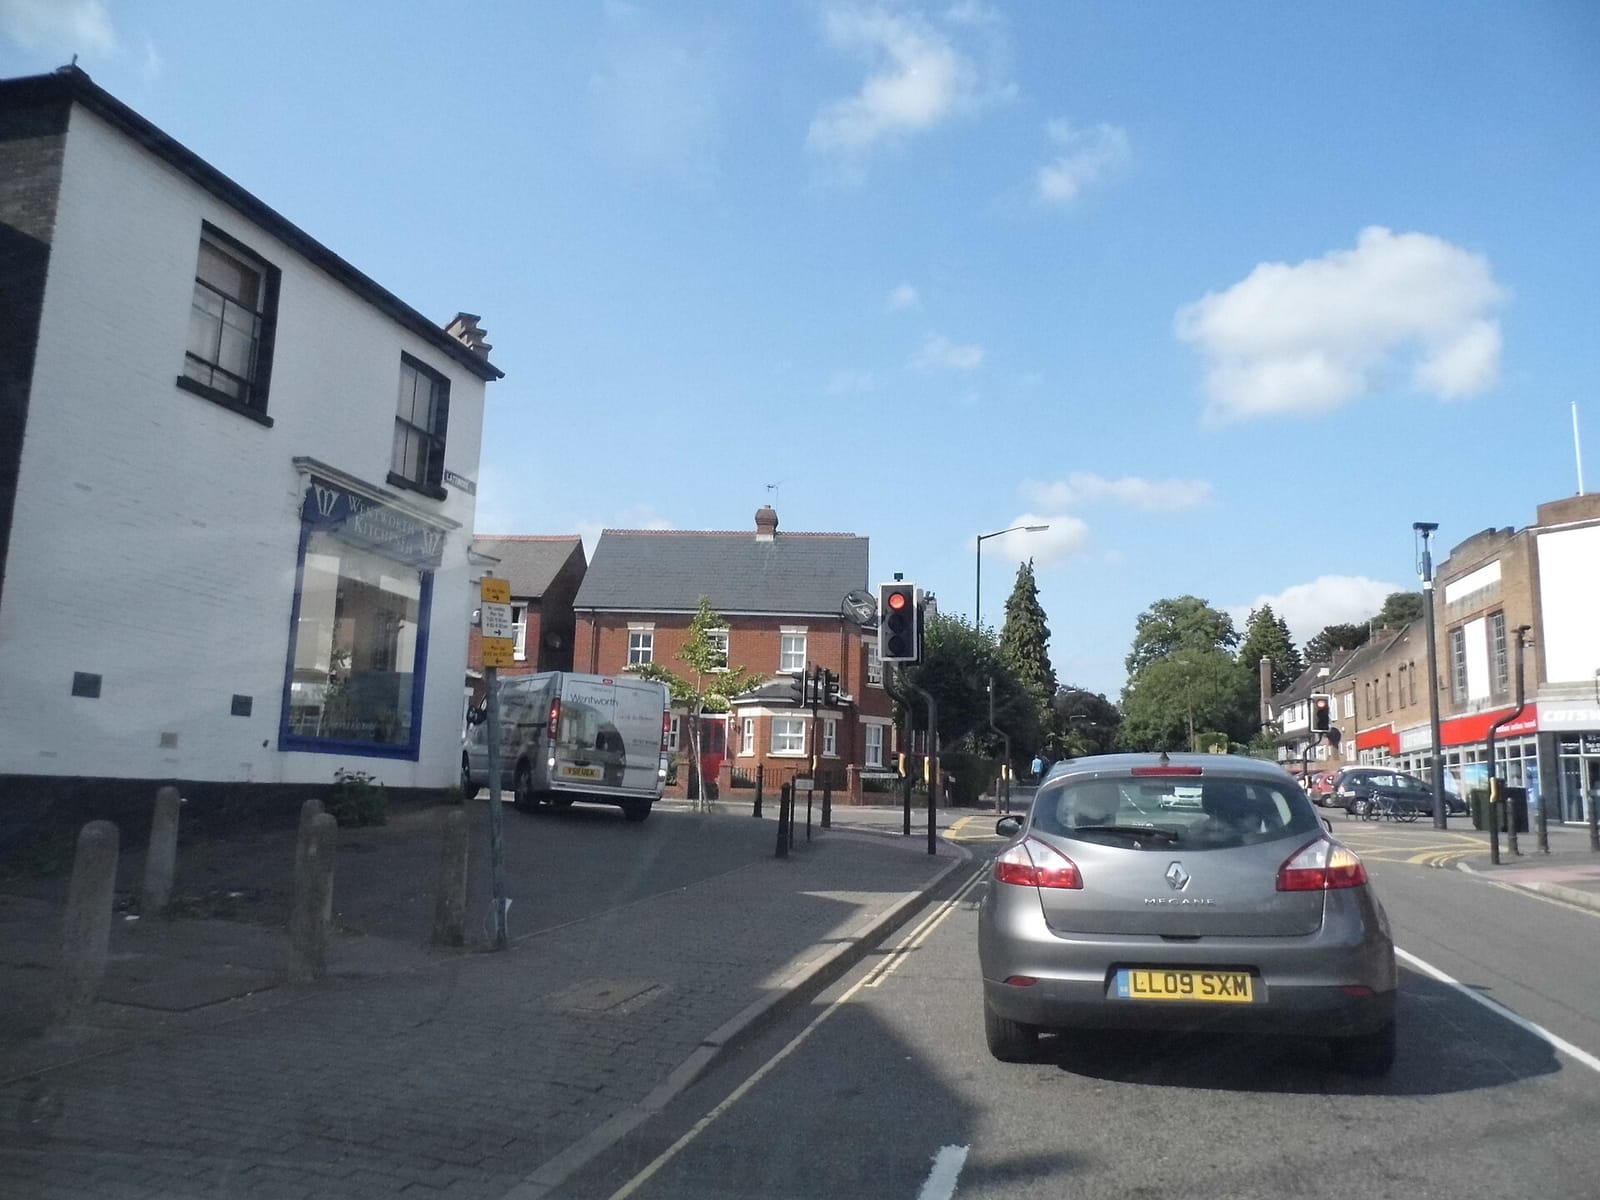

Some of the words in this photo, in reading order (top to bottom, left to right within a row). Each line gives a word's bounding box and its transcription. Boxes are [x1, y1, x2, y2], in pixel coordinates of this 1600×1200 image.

[348, 494, 416, 535] WENTWORTH
[570, 694, 619, 707] Wentworth
[1144, 898, 1216, 906] MEGANE
[1133, 973, 1194, 994] LL09
[1201, 975, 1248, 997] SXM
